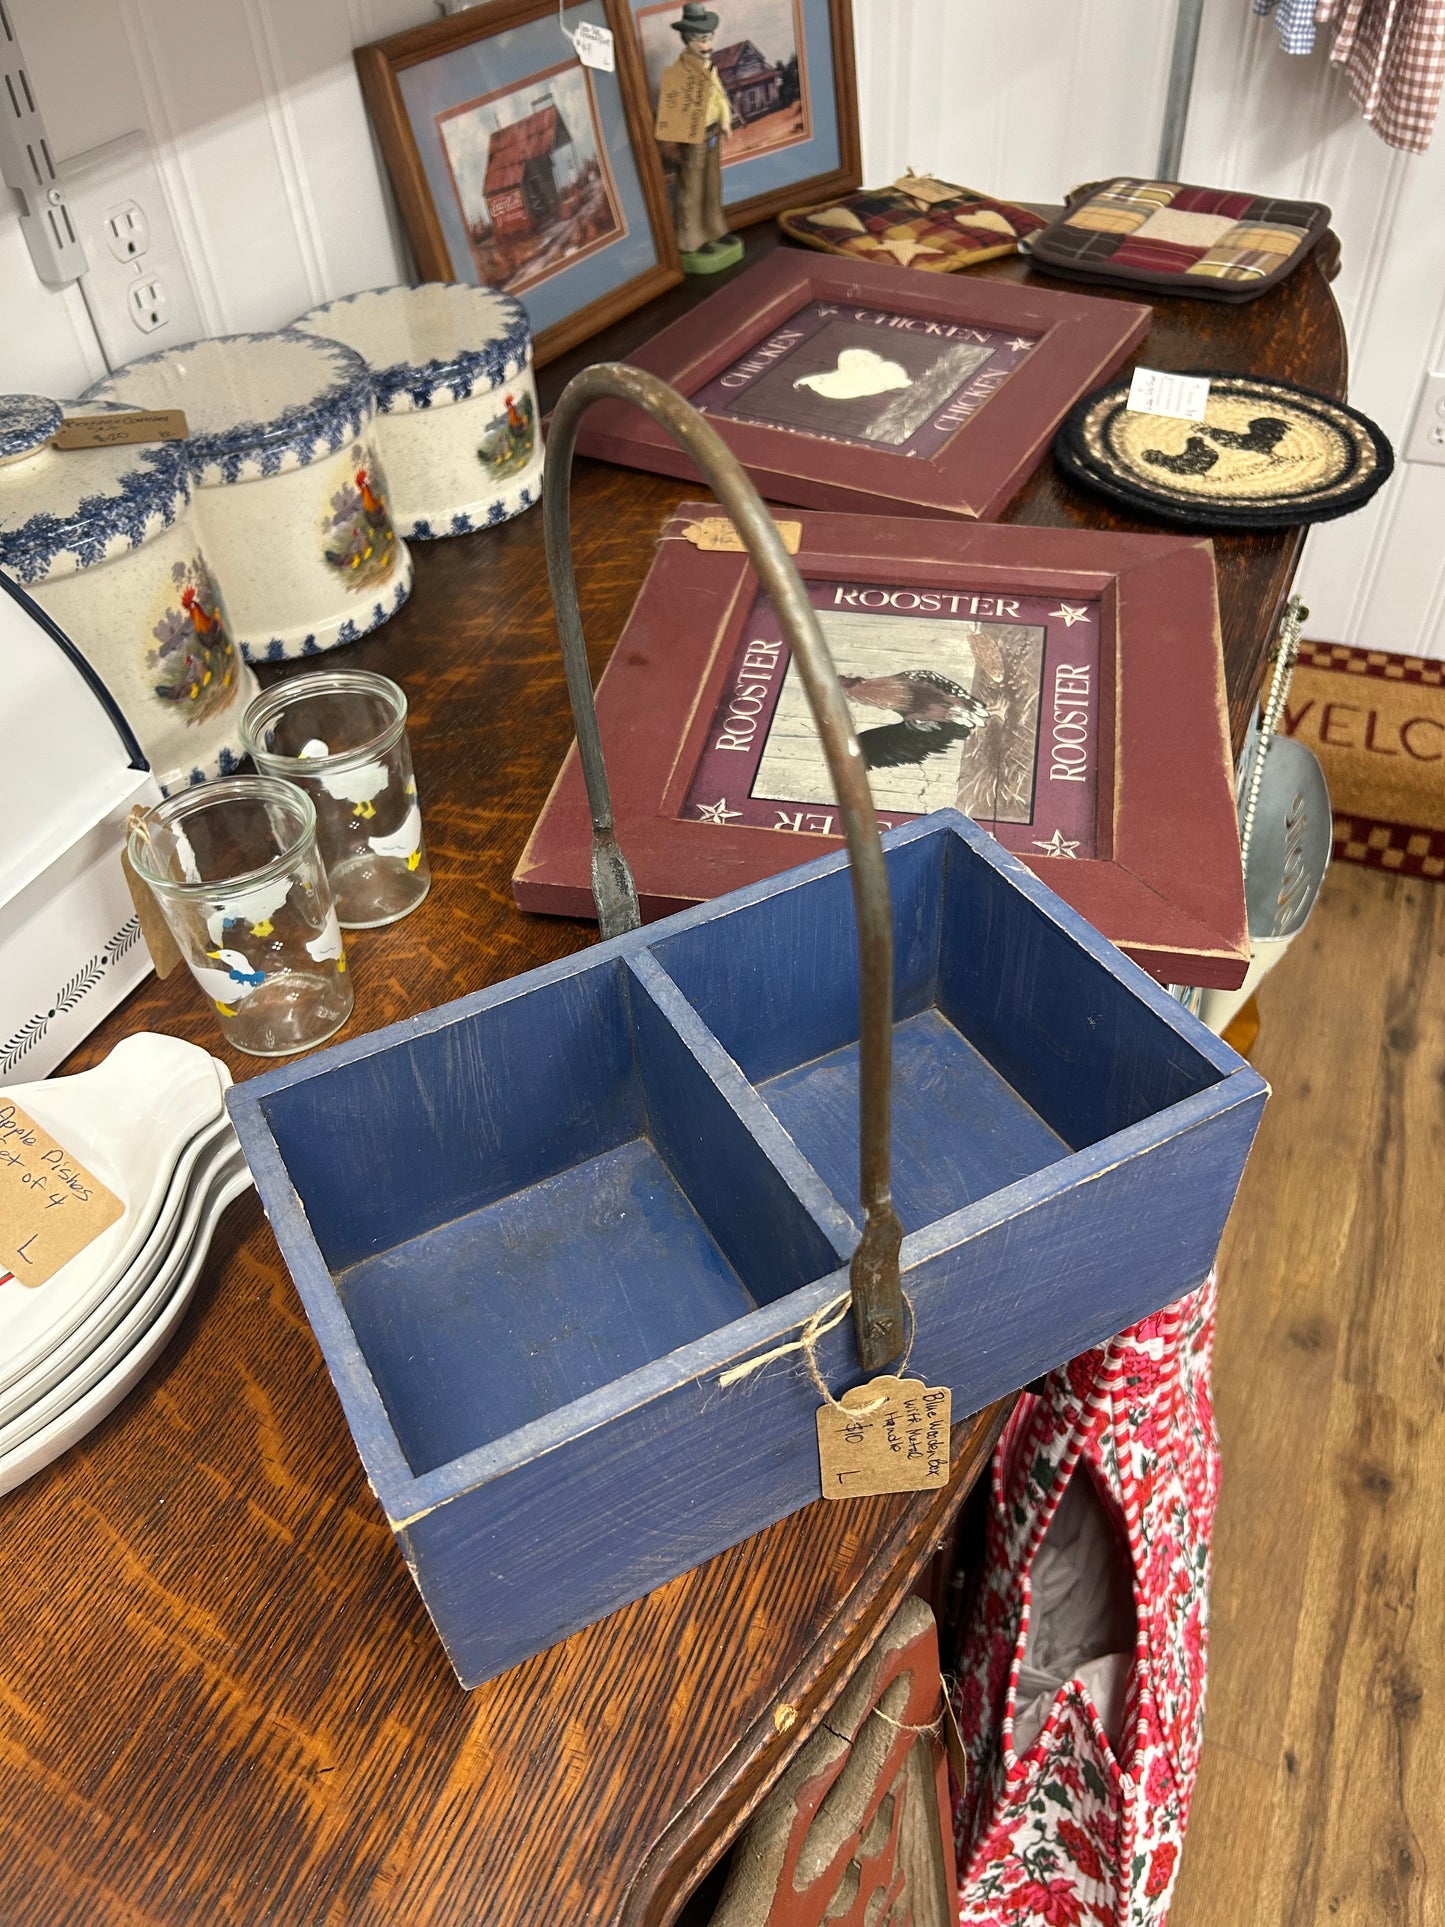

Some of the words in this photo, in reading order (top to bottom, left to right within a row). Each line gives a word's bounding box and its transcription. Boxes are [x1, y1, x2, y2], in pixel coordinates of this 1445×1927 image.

[855, 309, 992, 343] CHICKEN
[720, 330, 804, 388] CHICKEN
[933, 368, 1011, 431] CHICKEN
[833, 587, 1022, 618] ROOSTER
[715, 638, 783, 753] ROOSTER
[1049, 663, 1092, 783] ROOSTER
[0, 1106, 37, 1146] Apple
[22, 1173, 47, 1191] of
[45, 1193, 69, 1209] 4
[17, 1233, 38, 1265] L
[922, 1391, 945, 1418] Blue
[835, 1422, 873, 1444] $10
[906, 1428, 924, 1460] Metal
[926, 1420, 944, 1458] Wooden
[836, 1469, 861, 1484] L
